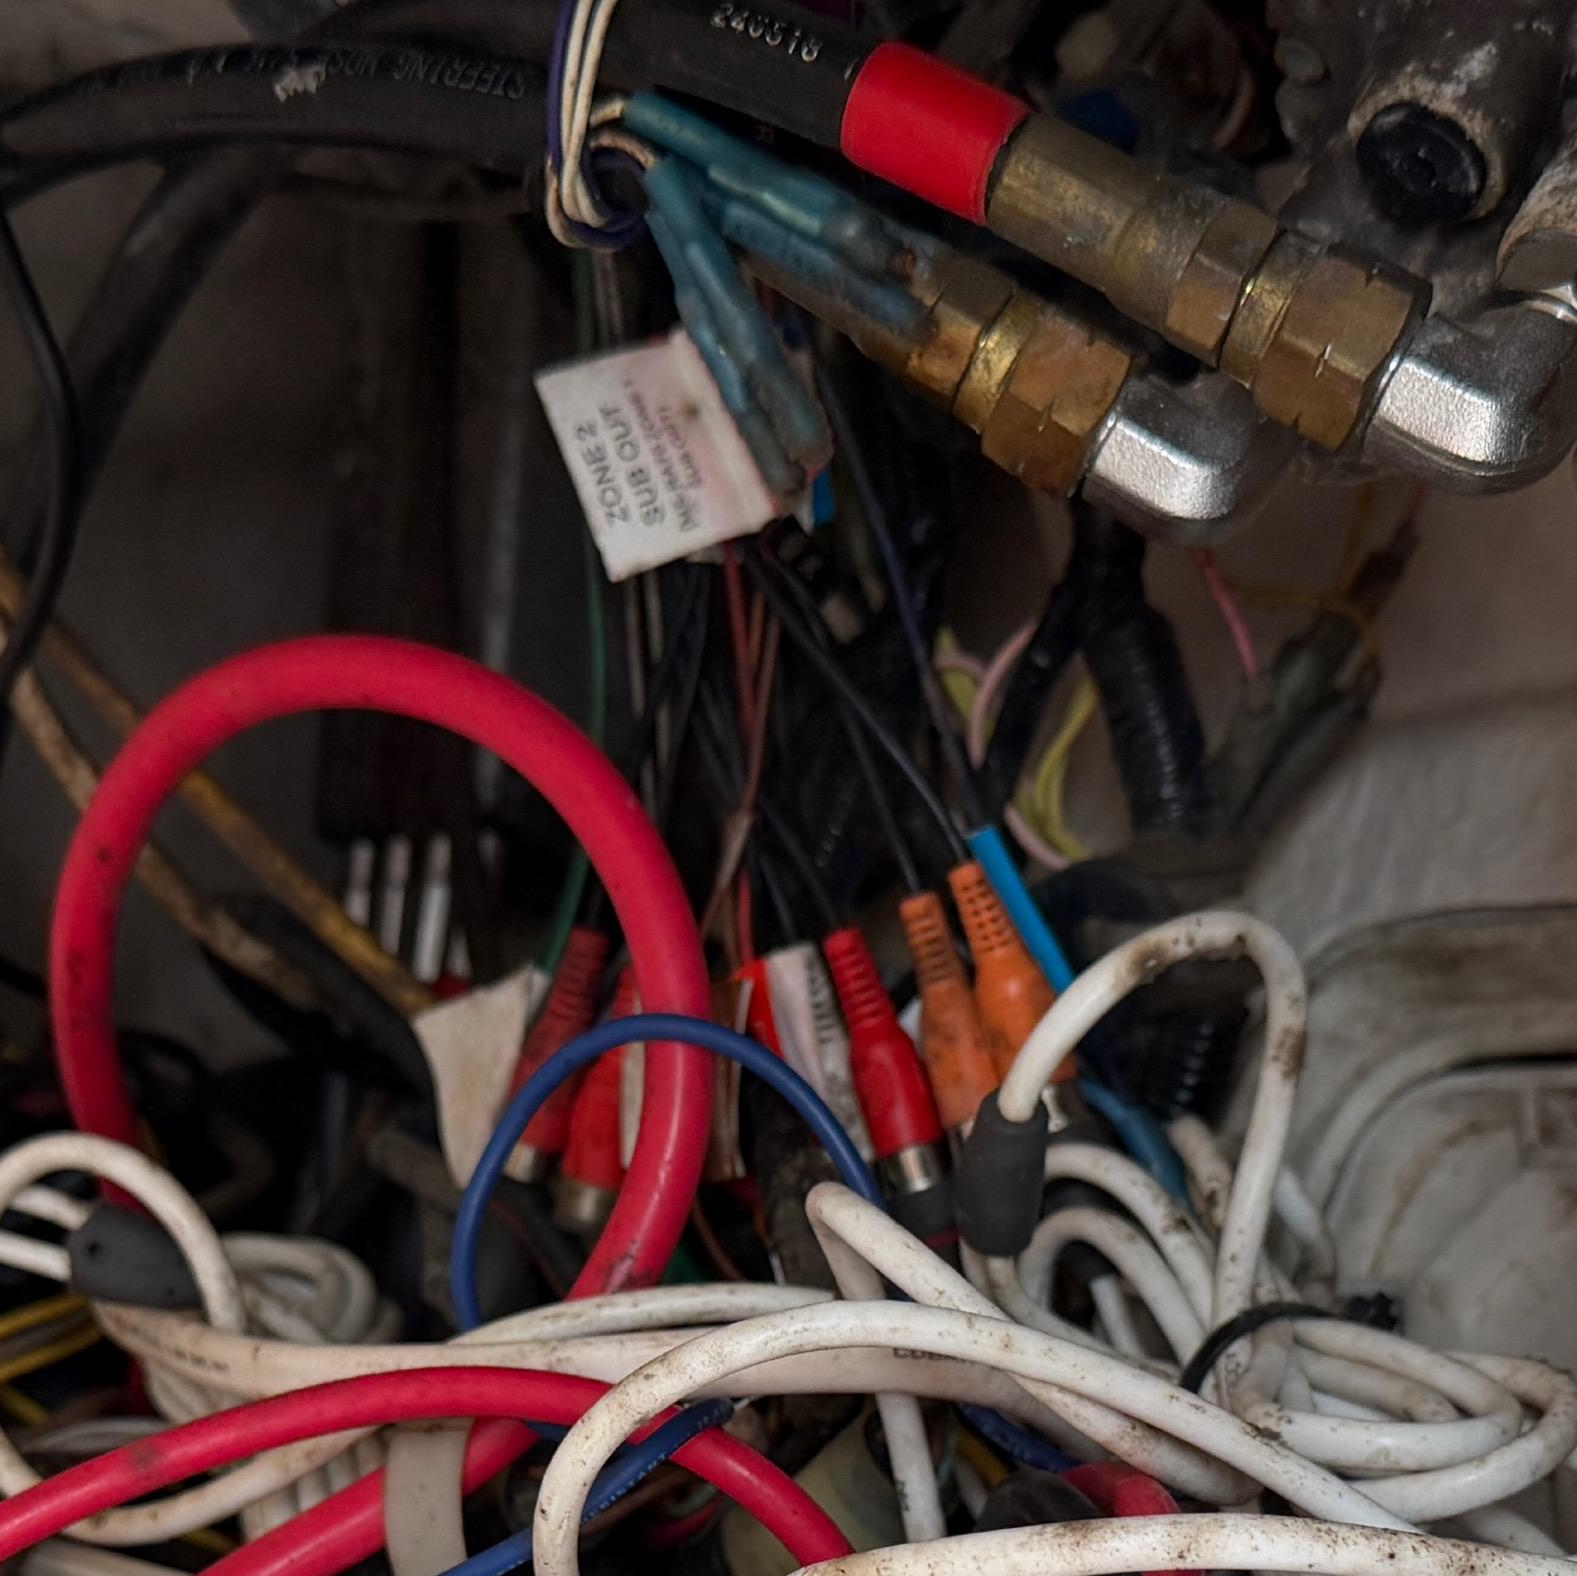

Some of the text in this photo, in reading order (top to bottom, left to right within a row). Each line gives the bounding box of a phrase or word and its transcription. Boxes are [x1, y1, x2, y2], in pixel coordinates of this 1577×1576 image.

[574, 419, 630, 527] ZONE 2
[598, 401, 667, 528] SUB OUT
